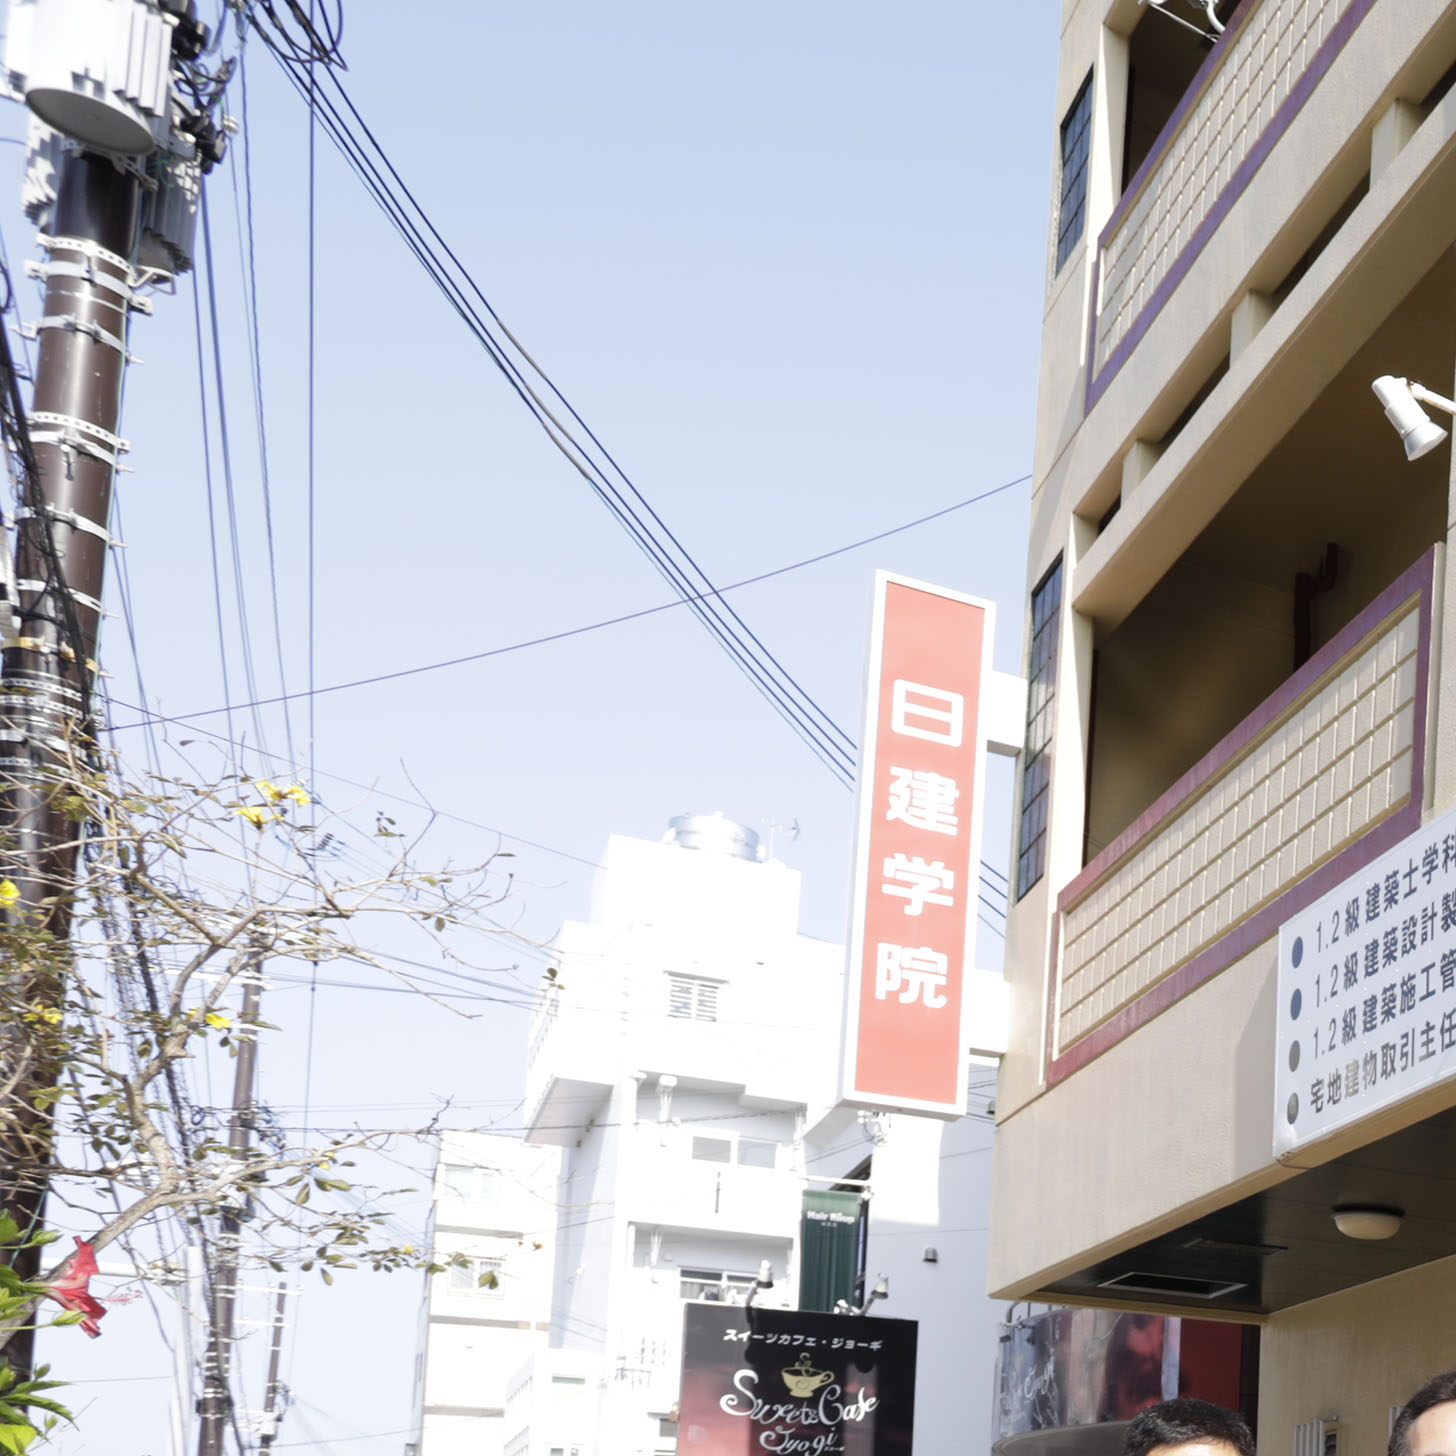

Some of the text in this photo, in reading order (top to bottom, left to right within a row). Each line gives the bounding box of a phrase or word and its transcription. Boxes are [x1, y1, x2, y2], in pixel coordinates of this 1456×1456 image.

[874, 679, 964, 1009] 日建学院
[723, 1329, 883, 1350] スイーツカフェ・ジョーギ
[720, 1369, 818, 1425] Sweets
